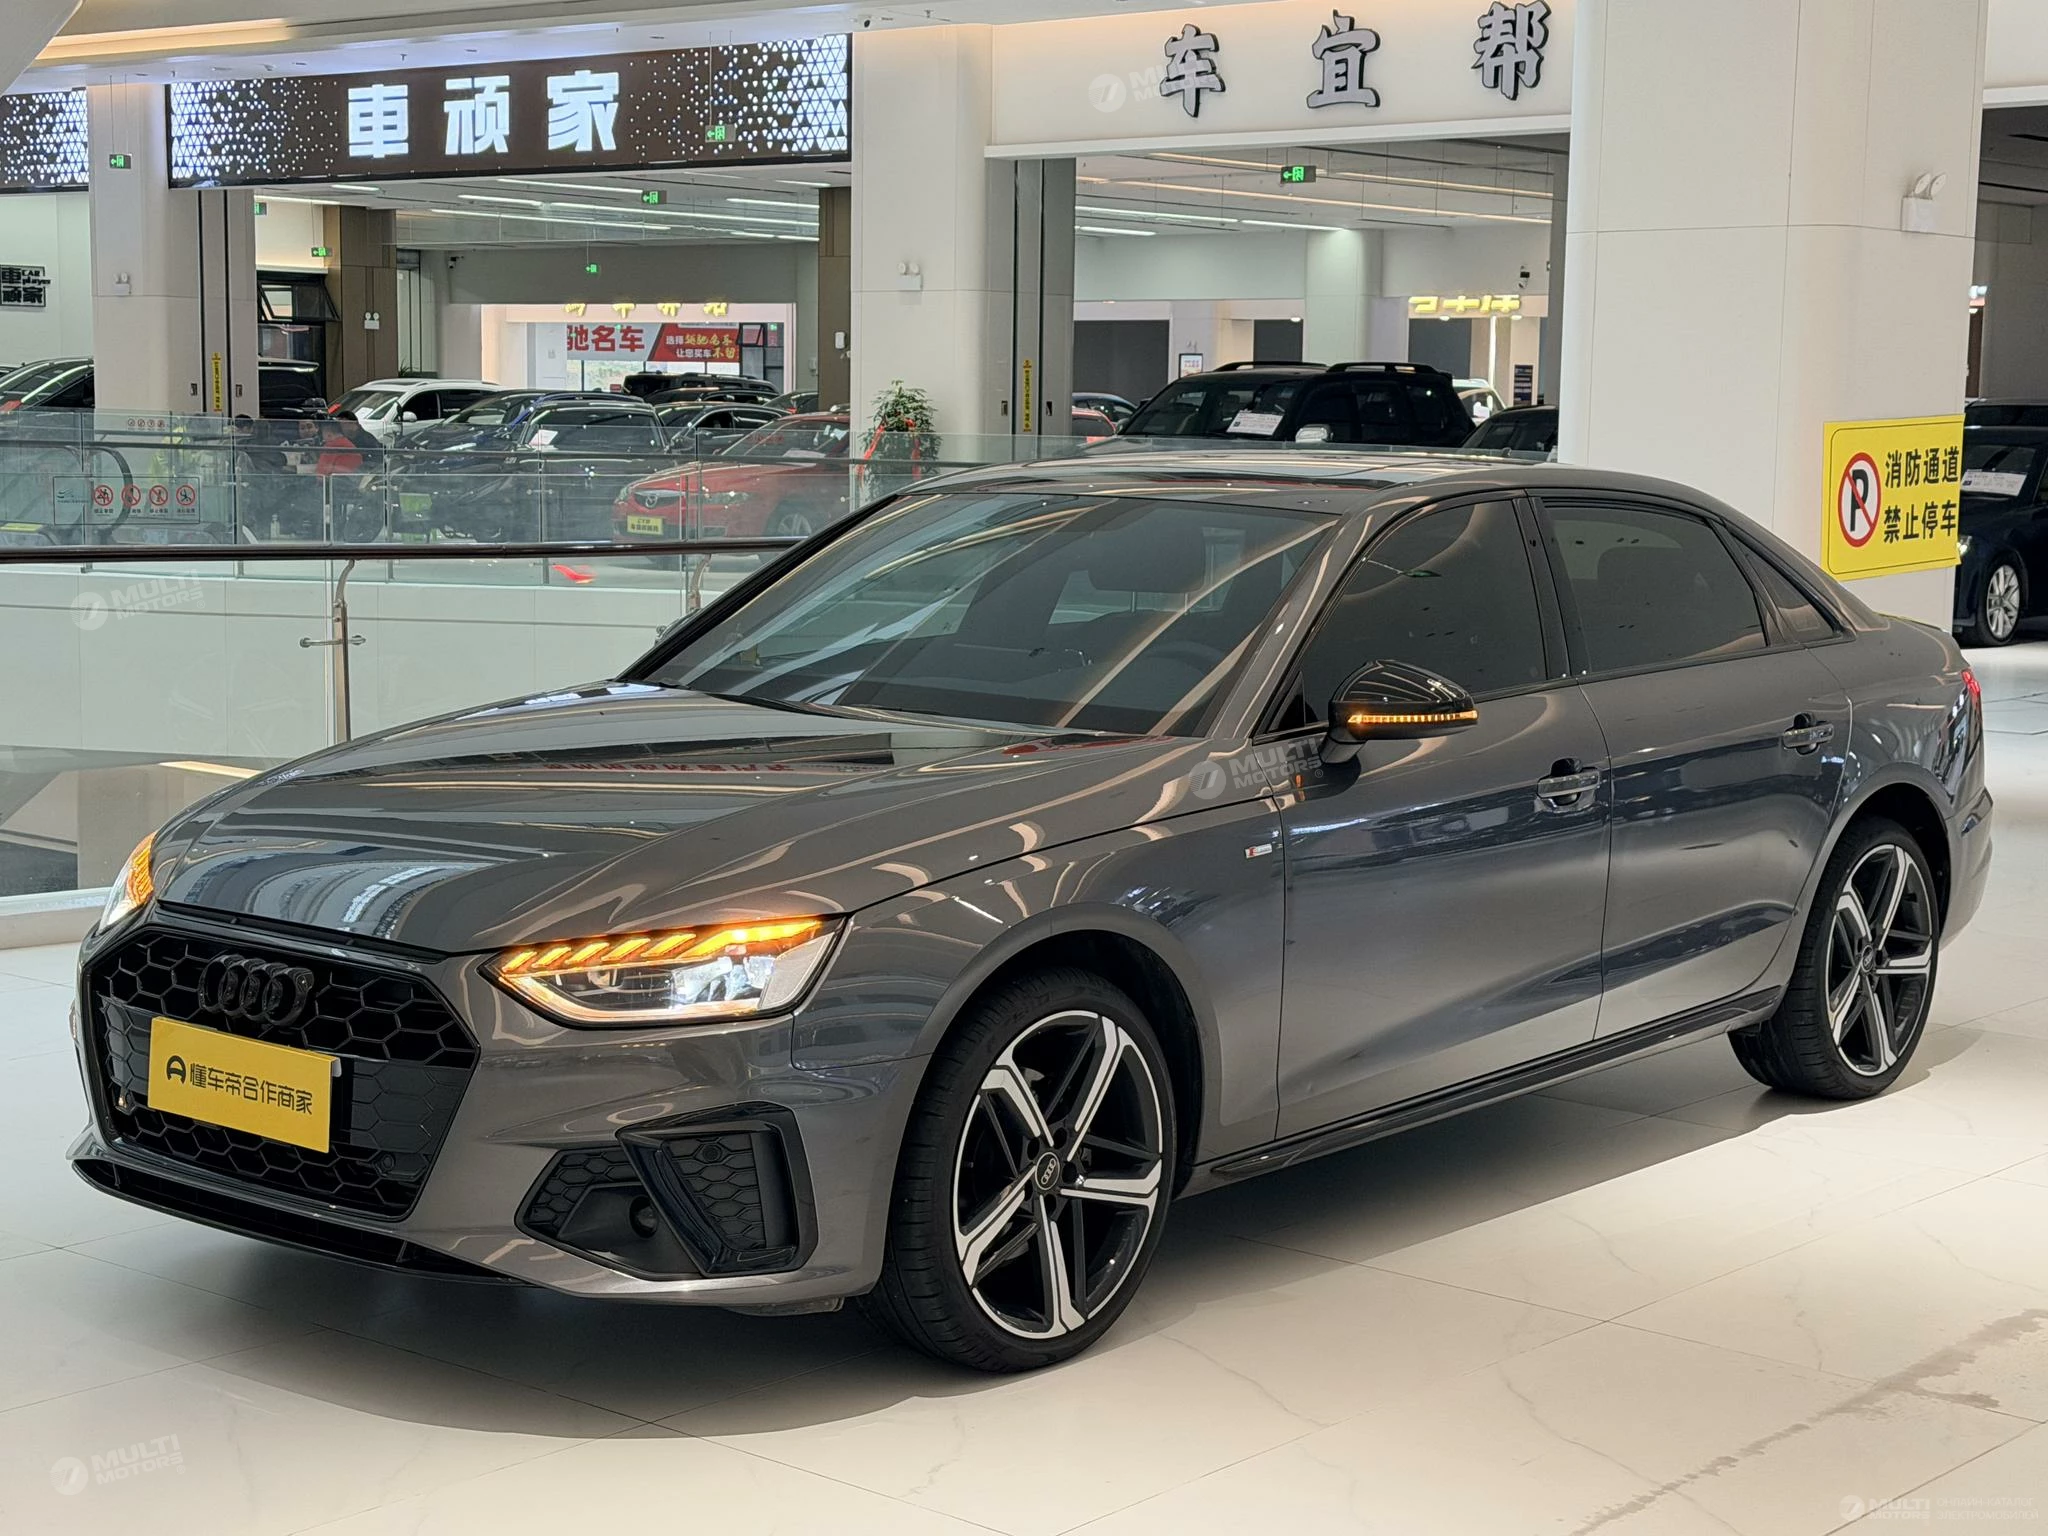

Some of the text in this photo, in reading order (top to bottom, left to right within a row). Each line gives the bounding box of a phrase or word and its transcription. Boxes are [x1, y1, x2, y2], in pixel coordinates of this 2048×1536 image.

[1160, 0, 1552, 118] 车宜帮
[567, 324, 645, 353] 驰名车
[1884, 445, 1960, 489] 消防通道
[1883, 499, 1957, 544] 禁止停车
[189, 1062, 313, 1115] 懂车帝合作商家
